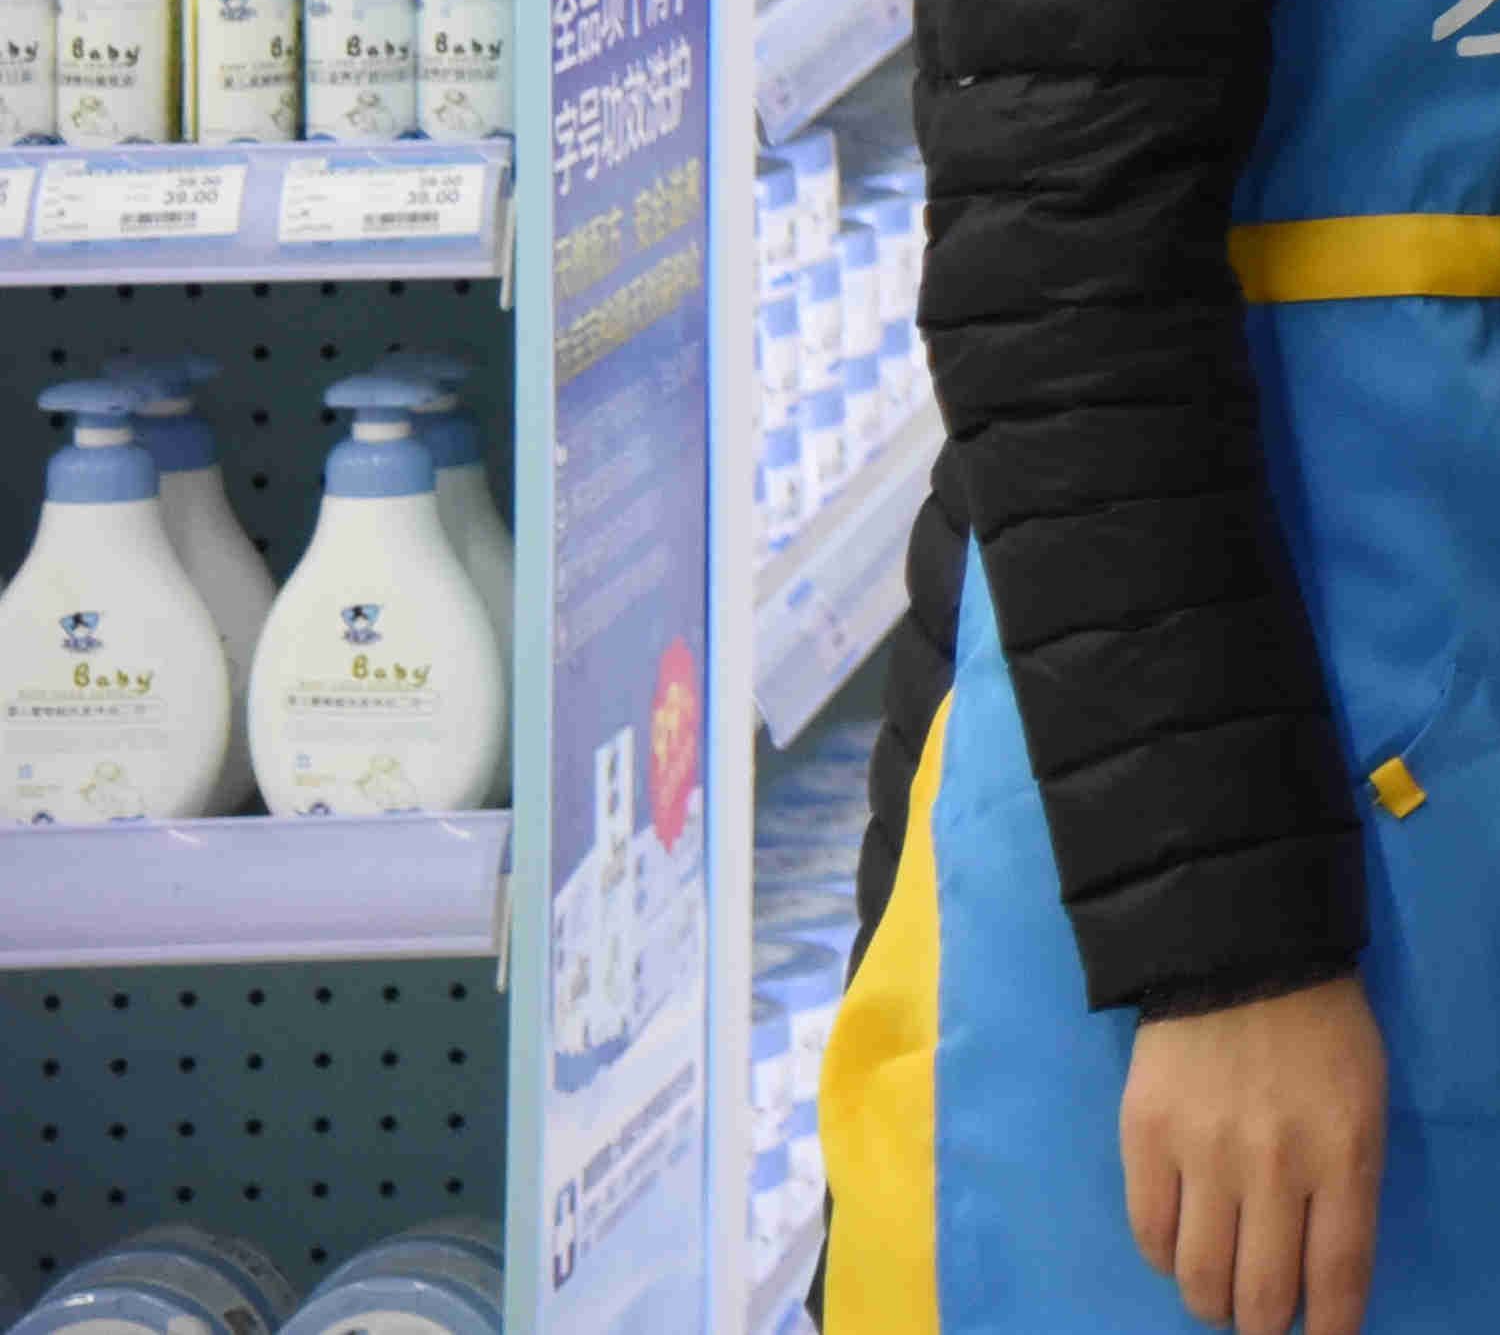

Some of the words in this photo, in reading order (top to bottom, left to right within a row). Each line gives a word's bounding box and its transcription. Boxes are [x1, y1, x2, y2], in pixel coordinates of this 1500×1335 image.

[71, 35, 141, 66] Baby
[74, 661, 154, 696] Baby
[352, 653, 432, 688] Baby
